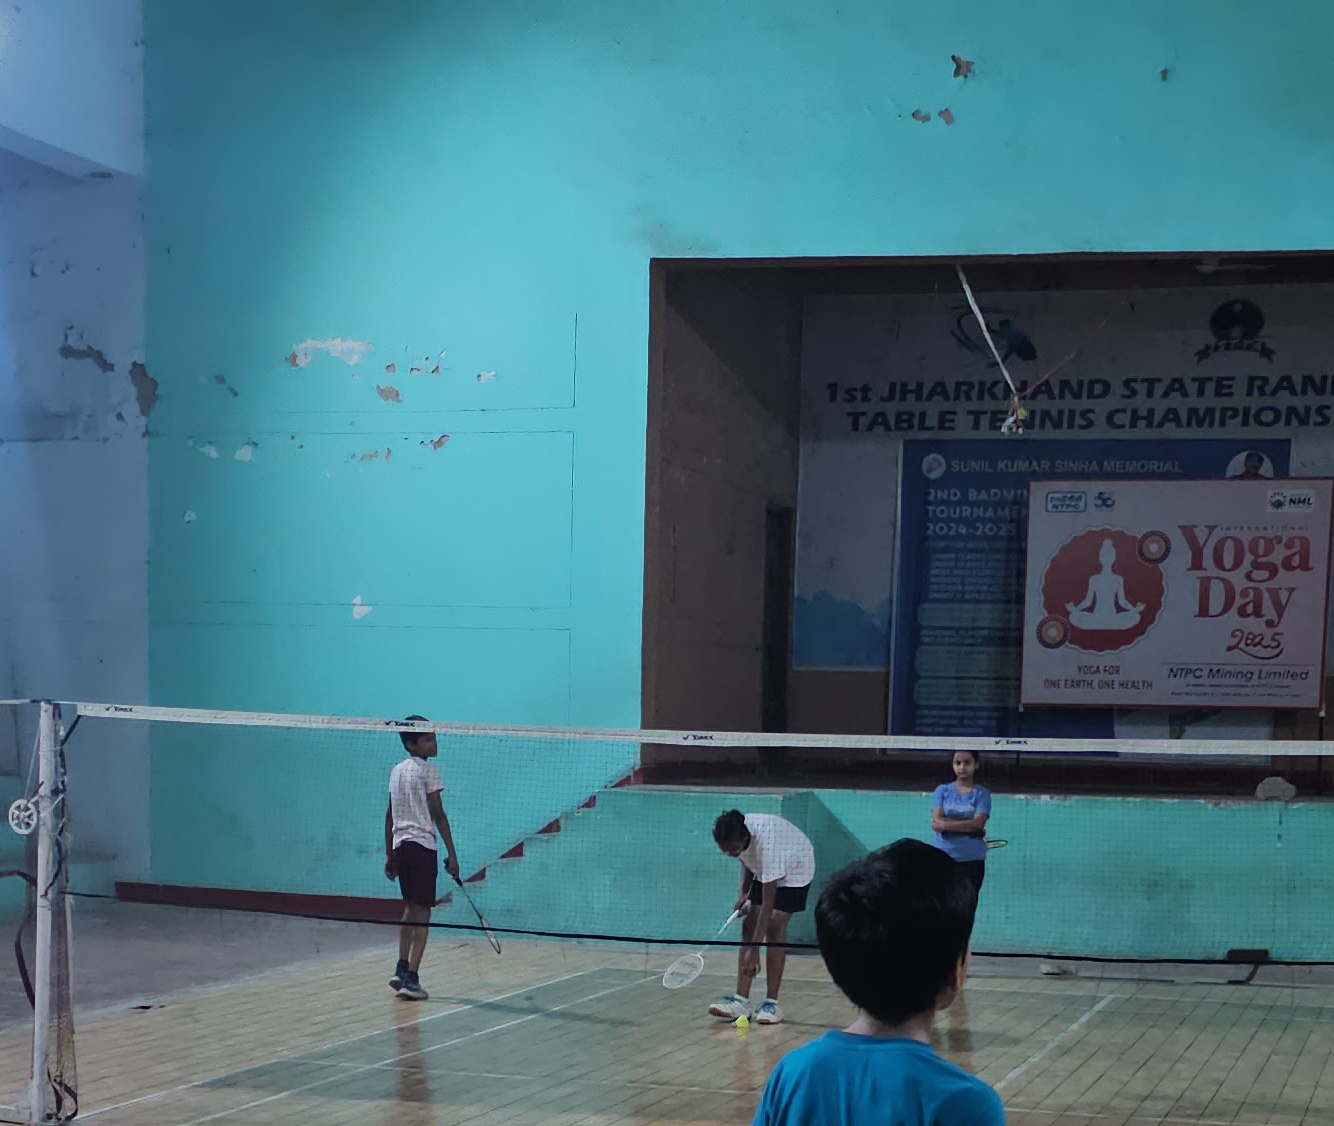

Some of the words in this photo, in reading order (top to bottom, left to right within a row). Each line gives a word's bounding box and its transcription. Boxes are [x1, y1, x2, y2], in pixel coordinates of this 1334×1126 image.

[827, 381, 873, 404] 1st
[879, 378, 1111, 403] JHARKHAND
[1120, 375, 1236, 400] STATE
[847, 409, 958, 433] TABLE
[950, 459, 994, 473] SUNIL
[997, 459, 1051, 473] KUMAR
[1054, 459, 1099, 473] SINHA
[1102, 460, 1183, 474] MEMORIAL
[927, 487, 962, 502] 2ND
[1288, 497, 1313, 506] NML
[1177, 524, 1314, 584] Yoga
[1193, 576, 1297, 629] Day
[1077, 664, 1101, 676] YOGA
[1103, 664, 1121, 676] FOR
[1167, 667, 1204, 681] NTPC
[1207, 668, 1254, 683] Mining
[1257, 668, 1310, 682] Limited
[1043, 678, 1062, 690] ONE
[1097, 679, 1116, 690] ONE
[1118, 679, 1154, 691] HEALTH
